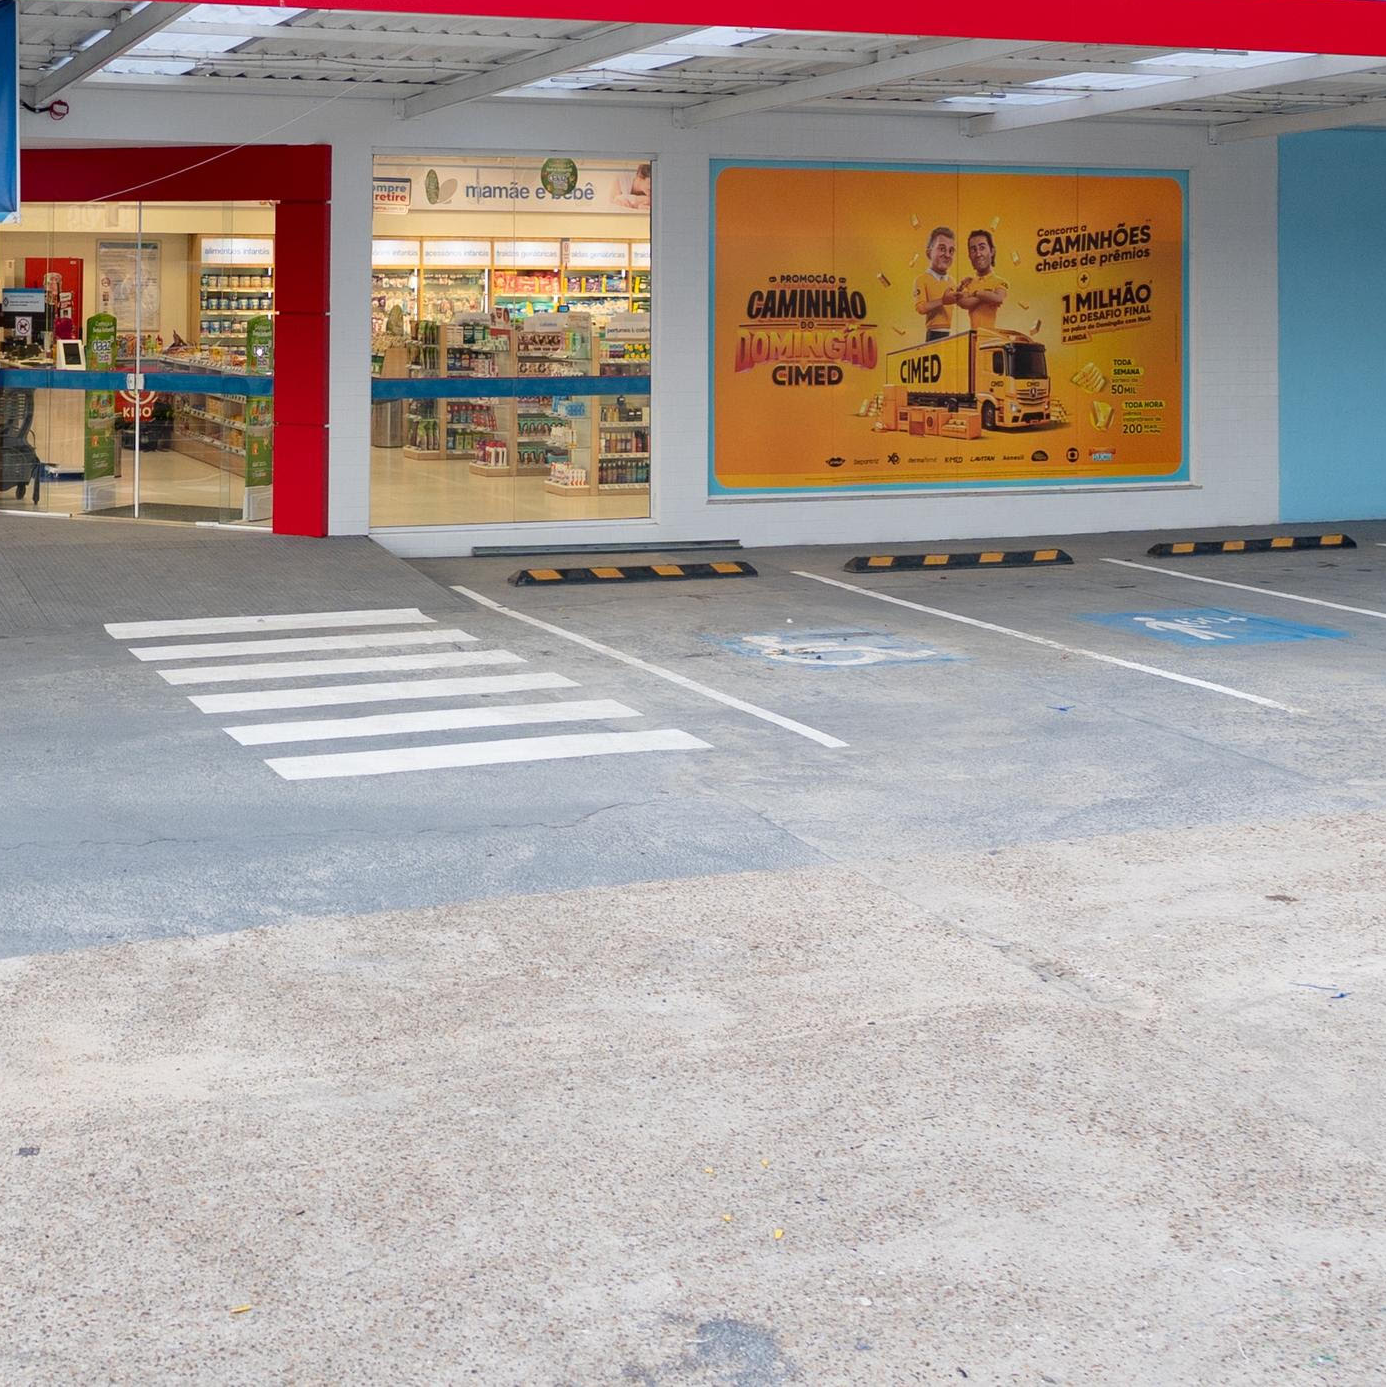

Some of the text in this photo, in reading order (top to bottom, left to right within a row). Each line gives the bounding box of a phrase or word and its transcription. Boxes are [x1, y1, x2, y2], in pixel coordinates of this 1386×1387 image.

[373, 185, 406, 193] mpre
[374, 192, 407, 202] retire
[465, 182, 530, 200] mamãe
[535, 187, 546, 199] e
[1036, 223, 1151, 257] CAMINHÕES
[1037, 227, 1079, 237] Concorra
[1035, 246, 1150, 272] cheios de prêmios
[780, 273, 836, 284] PROMOÇÃO
[746, 286, 867, 319] CAMINHÃO
[1062, 280, 1152, 313] 1 MILHÃO
[1062, 304, 1151, 325] NO DESAFIO FINAL
[800, 321, 815, 330] DO
[734, 324, 878, 373] DOMINGÃO
[772, 365, 844, 386] CIMED
[900, 353, 942, 384] CIMED
[1111, 385, 1124, 394] 50
[1123, 424, 1143, 434] 200
